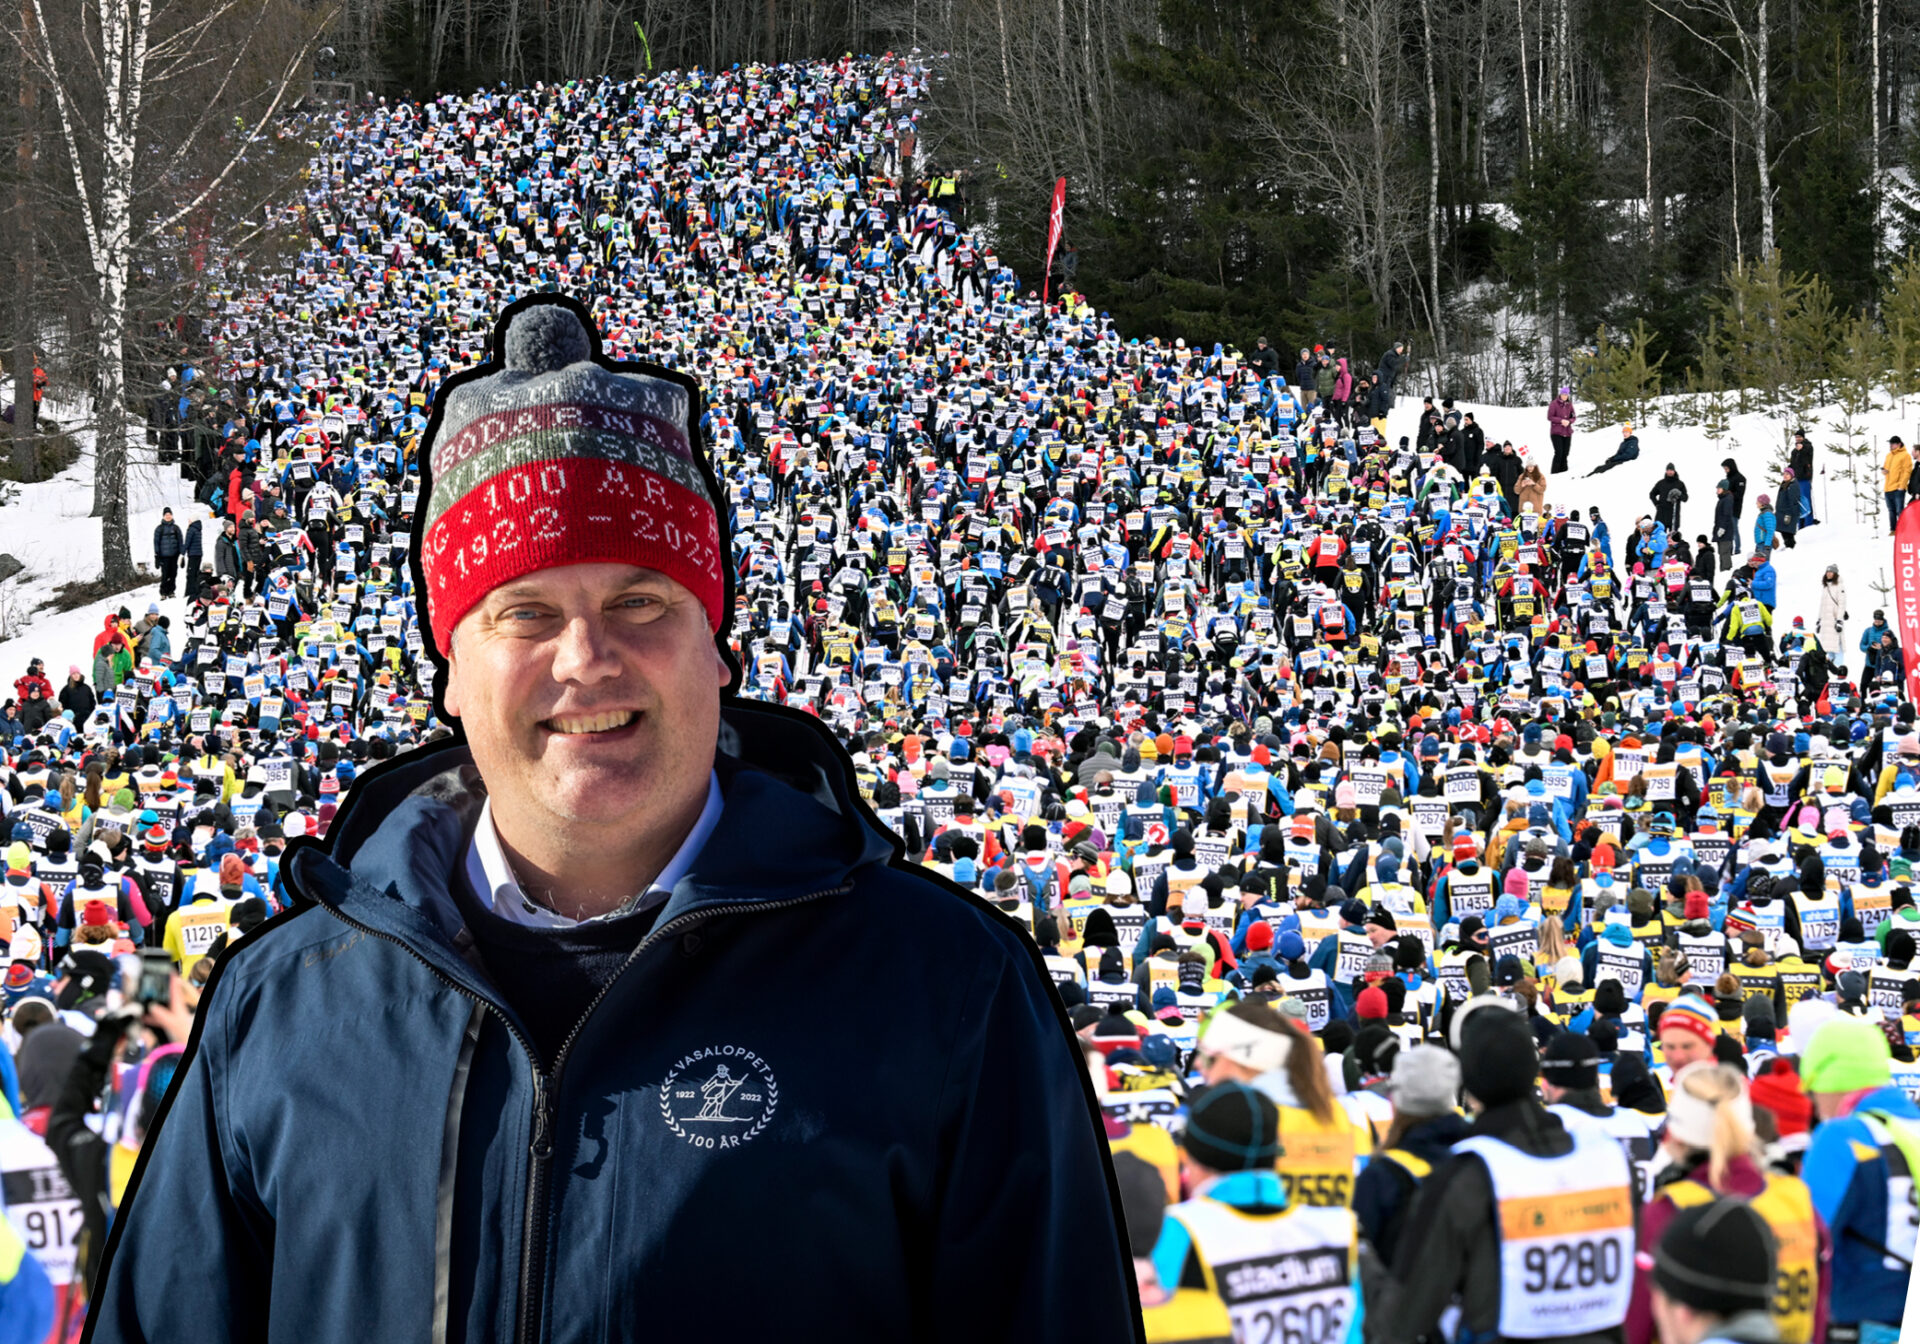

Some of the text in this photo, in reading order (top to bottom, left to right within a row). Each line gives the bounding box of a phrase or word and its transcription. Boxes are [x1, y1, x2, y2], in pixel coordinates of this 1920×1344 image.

[482, 465, 567, 516] 100
[454, 505, 567, 580] 1922
[630, 508, 719, 581] 2022
[1901, 542, 1919, 629] SKI POLE
[1453, 896, 1490, 909] 11435
[674, 1044, 771, 1075] VASALOPPET
[675, 1090, 696, 1099] 1922
[740, 1092, 762, 1102] 2022
[688, 1133, 741, 1149] 100 ÅR
[1226, 1254, 1343, 1299] stadium
[1524, 1237, 1621, 1293] 9280
